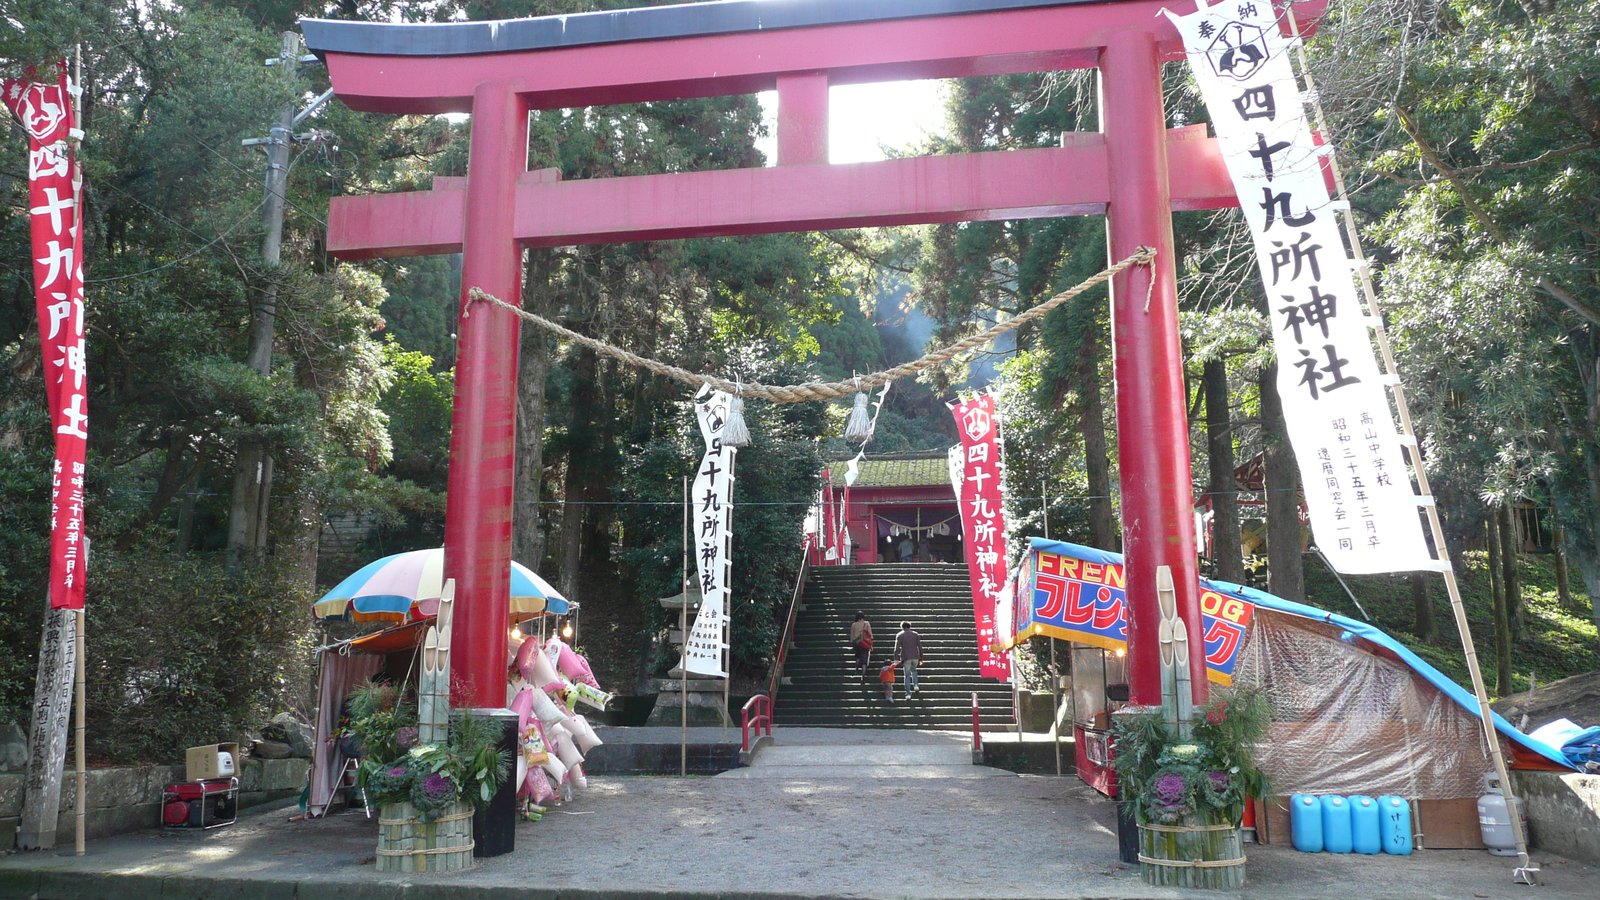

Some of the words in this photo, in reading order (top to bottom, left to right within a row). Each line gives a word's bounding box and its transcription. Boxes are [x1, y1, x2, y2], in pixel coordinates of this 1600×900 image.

[1231, 83, 1362, 401] 四十九所神社
[1317, 447, 1353, 551] 還暦同窓会一同
[1332, 417, 1380, 550] 昭和三十五年三月卒
[1360, 411, 1393, 487] 高山中学校
[966, 442, 1000, 598] 四十九所神社
[1038, 551, 1126, 589] FREN
[1200, 592, 1245, 623] OG
